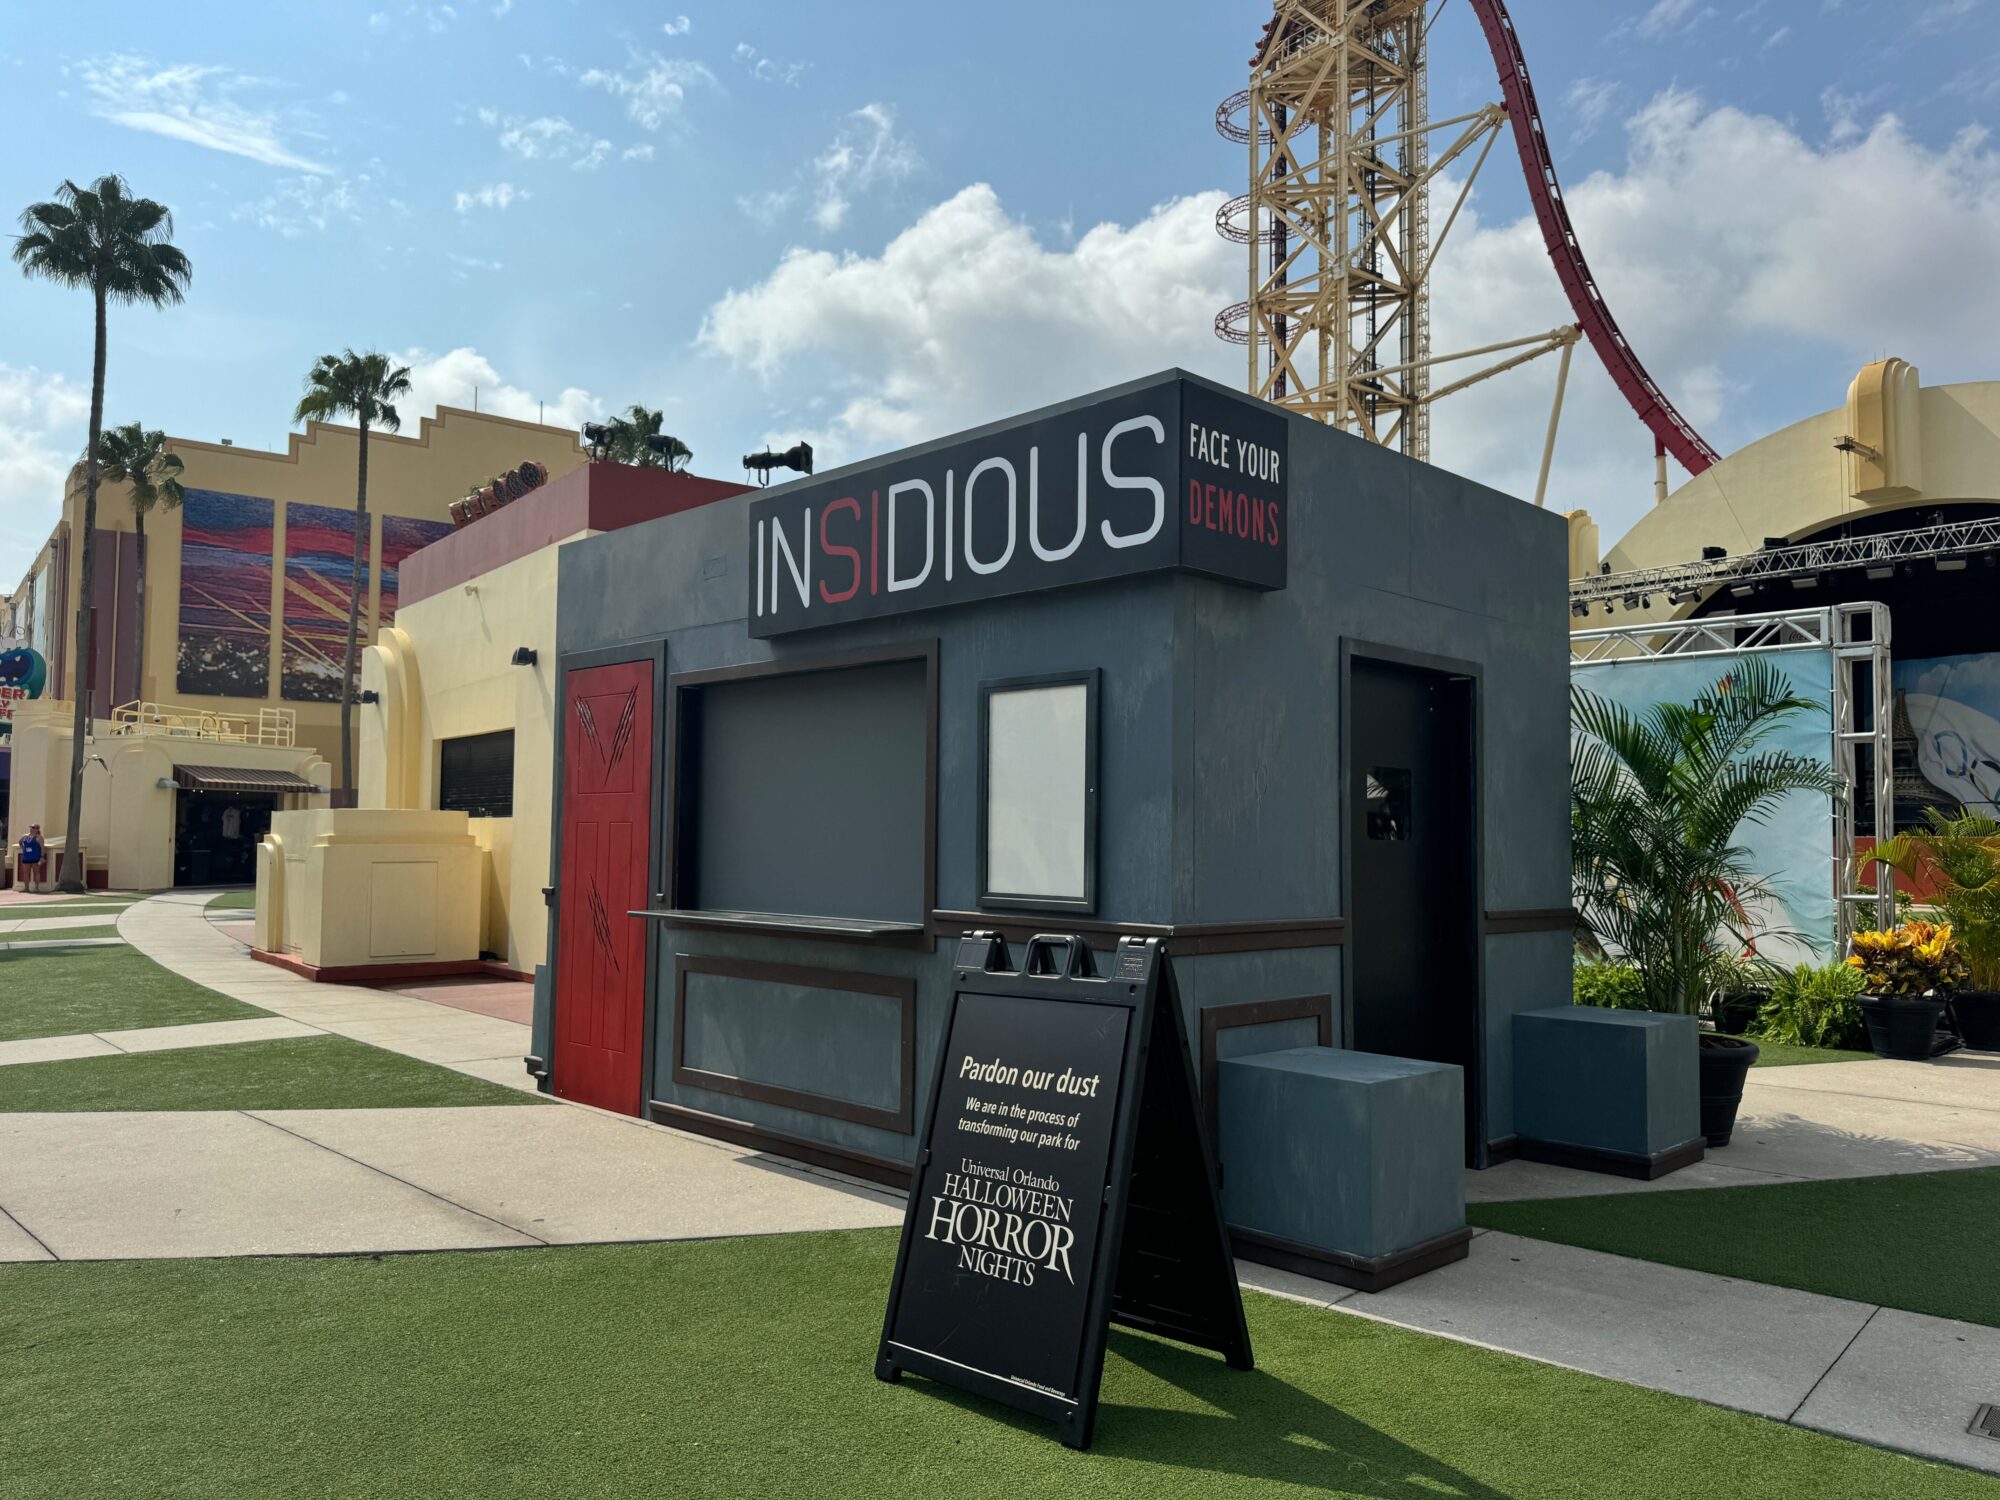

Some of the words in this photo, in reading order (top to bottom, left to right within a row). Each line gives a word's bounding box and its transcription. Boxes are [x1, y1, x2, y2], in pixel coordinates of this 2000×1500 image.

[1189, 422, 1230, 469] FACE
[1236, 438, 1280, 484] YOUR
[757, 414, 1165, 617] INSIDIOUS
[1189, 478, 1279, 546] DEMONS
[959, 1055, 1019, 1086] Pardon
[1021, 1069, 1055, 1091] our
[1056, 1067, 1100, 1098] dust
[958, 1117, 1019, 1144] transforming
[1020, 1130, 1039, 1144] our
[1037, 1132, 1062, 1149] park
[1063, 1133, 1081, 1151] for
[965, 1096, 981, 1112] We
[981, 1102, 997, 1115] are
[998, 1102, 1009, 1117] in
[1009, 1103, 1027, 1119] the
[1026, 1109, 1066, 1126] process
[1067, 1112, 1081, 1128] of
[942, 1172, 1074, 1223] HALLOWEEN
[961, 1158, 1010, 1182] Universal
[1012, 1168, 1060, 1192] Orlando
[924, 1196, 1075, 1286] HORROR
[957, 1244, 1036, 1287] NIGHTS
